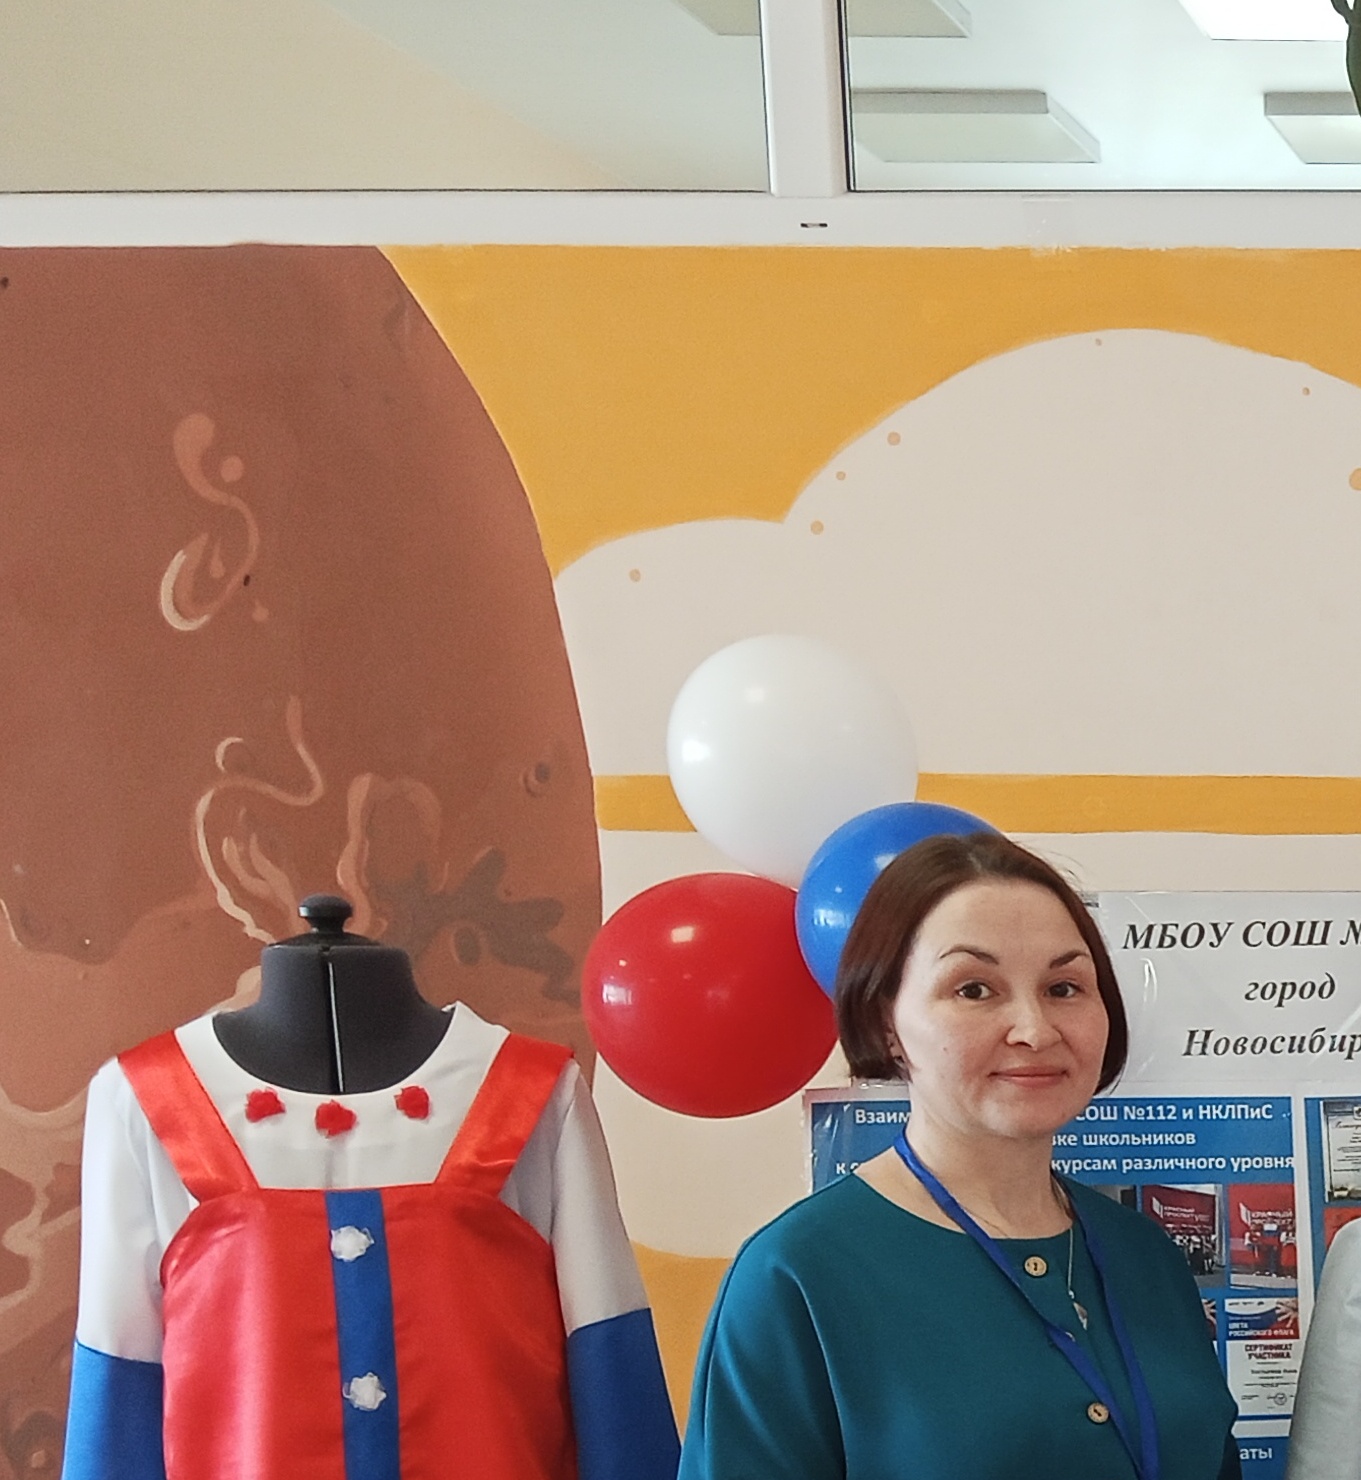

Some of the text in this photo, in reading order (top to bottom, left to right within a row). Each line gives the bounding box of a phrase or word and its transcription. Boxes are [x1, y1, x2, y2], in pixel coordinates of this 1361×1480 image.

[1122, 921, 1235, 950] МБОУ
[1241, 919, 1334, 948] СОШ
[1244, 972, 1337, 1008] город
[1123, 1104, 1177, 1121] №112
[1182, 1107, 1194, 1120] и
[1199, 1103, 1274, 1119] НКЛПиС
[1083, 1132, 1197, 1146] школьников
[1121, 1156, 1227, 1174] различного
[1230, 1155, 1294, 1173] уровня
